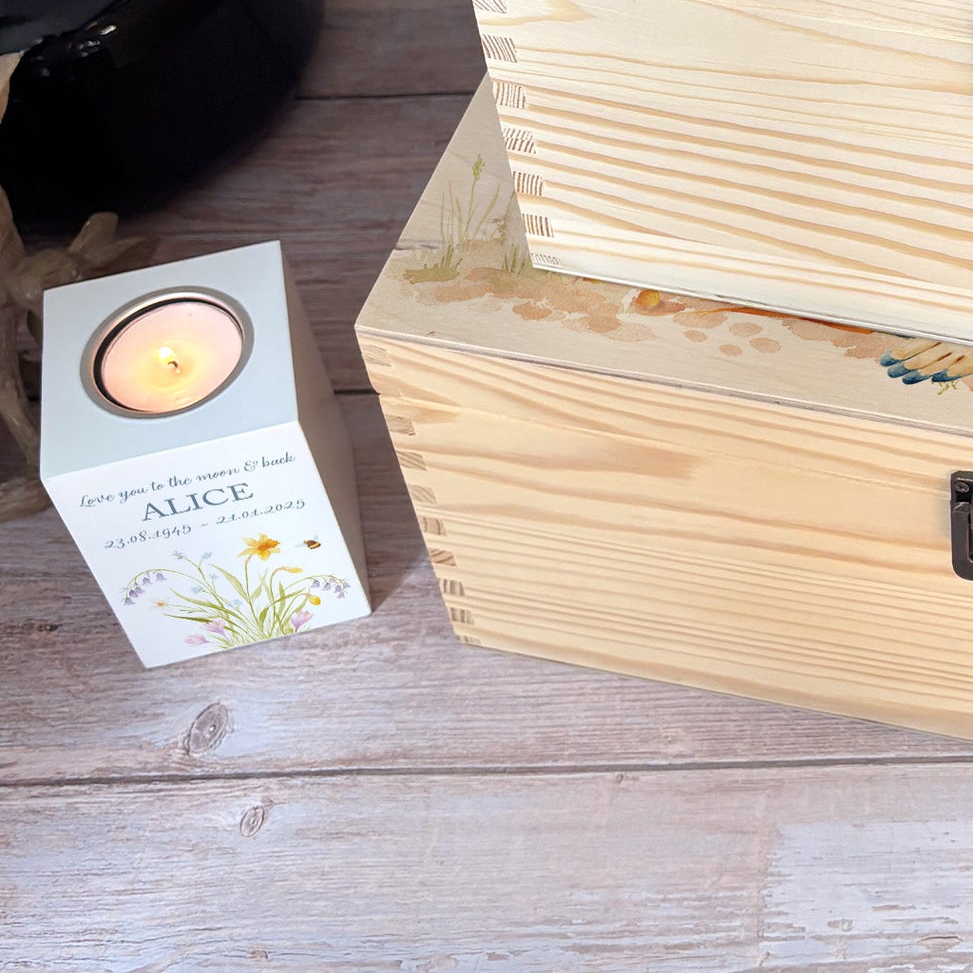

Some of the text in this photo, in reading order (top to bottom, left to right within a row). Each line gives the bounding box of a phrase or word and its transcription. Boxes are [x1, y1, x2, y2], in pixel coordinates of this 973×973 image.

[79, 451, 296, 508] Love you to the moon & back
[141, 483, 254, 522] ALICE
[104, 524, 192, 550] 23.08.1945
[215, 499, 306, 525] 21.01.2025
